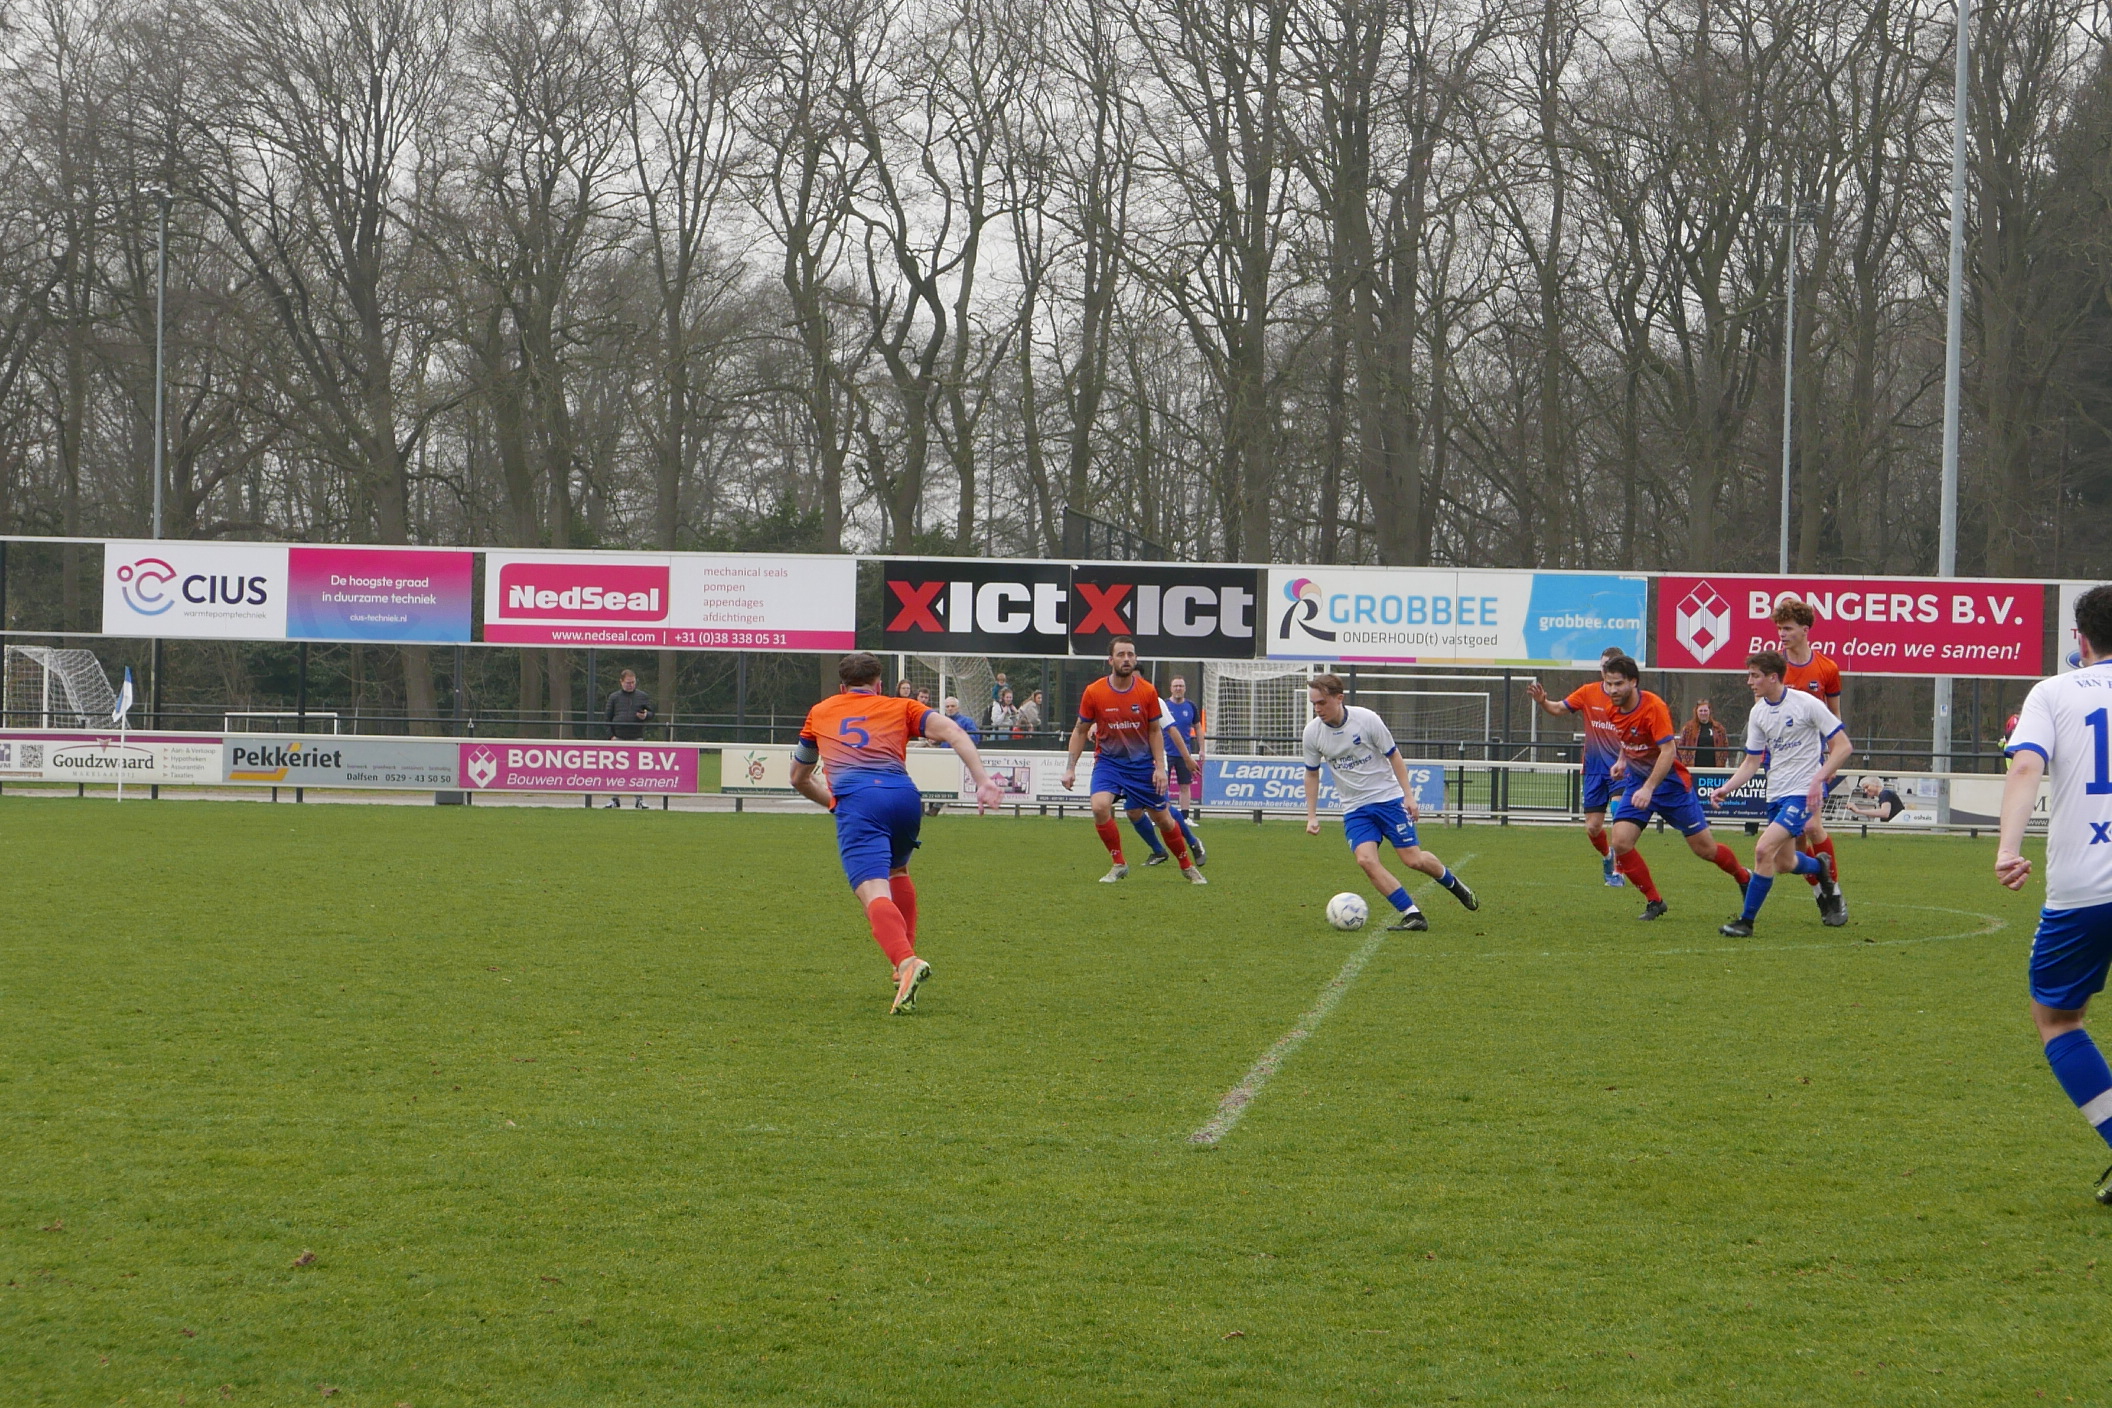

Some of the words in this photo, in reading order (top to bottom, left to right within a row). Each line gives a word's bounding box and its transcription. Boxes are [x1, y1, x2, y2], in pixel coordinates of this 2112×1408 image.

[703, 567, 761, 577] mechanical
[763, 568, 788, 577] seals
[330, 575, 347, 586] De
[349, 575, 393, 589] hoogste
[395, 577, 429, 589] graad
[703, 584, 745, 593] pompen
[182, 575, 268, 605] CIUS
[322, 591, 332, 602] in
[334, 592, 389, 604] duurzame
[391, 593, 437, 605] techniek
[509, 585, 659, 612] NedSeal
[703, 597, 764, 609] appendages
[1329, 594, 1498, 626] GROBBEE
[1952, 595, 2023, 625] B.V.
[350, 614, 408, 622] cius-techniek.nl
[702, 612, 765, 624] afdichtingen
[1539, 613, 1640, 631] grobbee.com
[552, 630, 656, 642] www.nedseal.com
[675, 632, 695, 643] +31
[699, 631, 728, 644] (0)38
[731, 632, 752, 644] 338
[755, 633, 769, 644] 05
[772, 633, 787, 645] 31
[1343, 631, 1438, 646] ONDERHOUD(t)
[1442, 634, 1498, 648] vastgoed
[1842, 638, 1896, 656] doen
[1904, 643, 1935, 658] we
[1941, 643, 2021, 660] samen!
[839, 717, 870, 749] 5
[232, 746, 342, 768] Pekkeriet
[508, 749, 630, 770] BONGERS
[638, 752, 680, 771] B.V.
[346, 772, 378, 781] Dalfsen
[385, 774, 406, 782] 0529
[440, 775, 451, 783] 50
[1219, 761, 1323, 780] Laarma
[507, 773, 563, 786] Bouwen
[566, 775, 601, 787] doen
[606, 777, 625, 787] we
[629, 777, 679, 788] samen!
[1225, 783, 1255, 797] en
